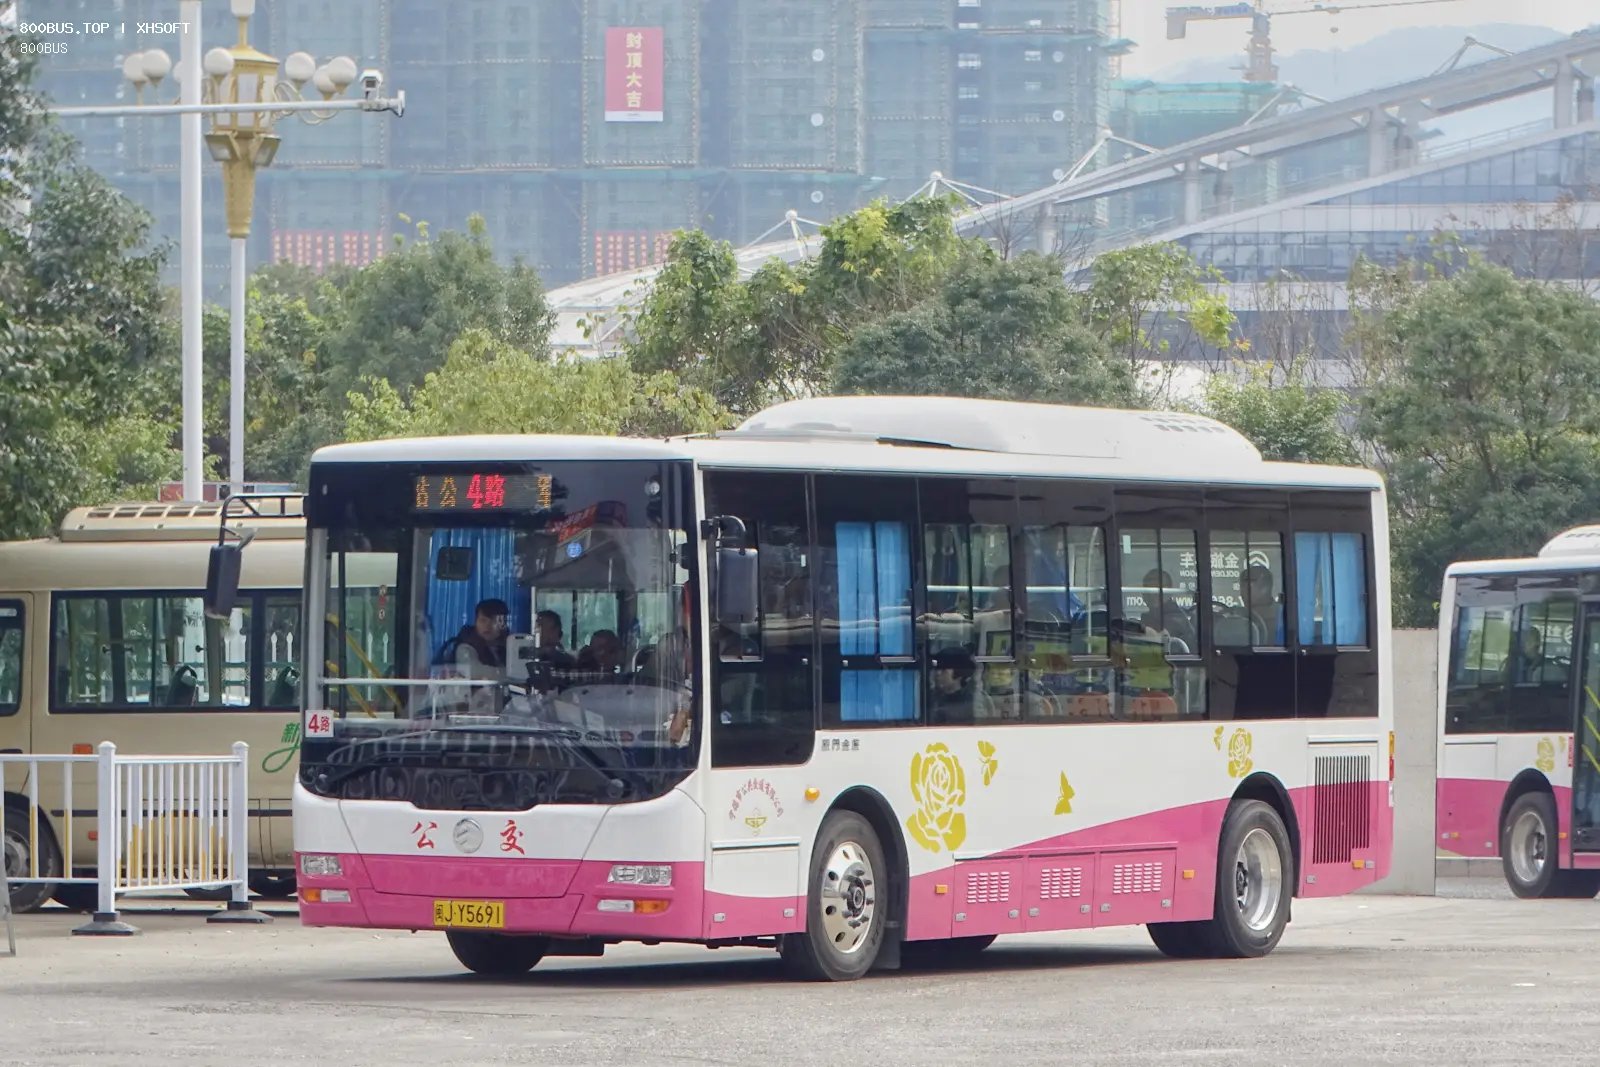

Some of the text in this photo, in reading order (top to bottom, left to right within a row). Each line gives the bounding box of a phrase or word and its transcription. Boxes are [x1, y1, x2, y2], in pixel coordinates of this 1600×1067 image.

[466, 474, 505, 508] 4路
[308, 713, 330, 733] 4路
[411, 819, 525, 855] 公 交
